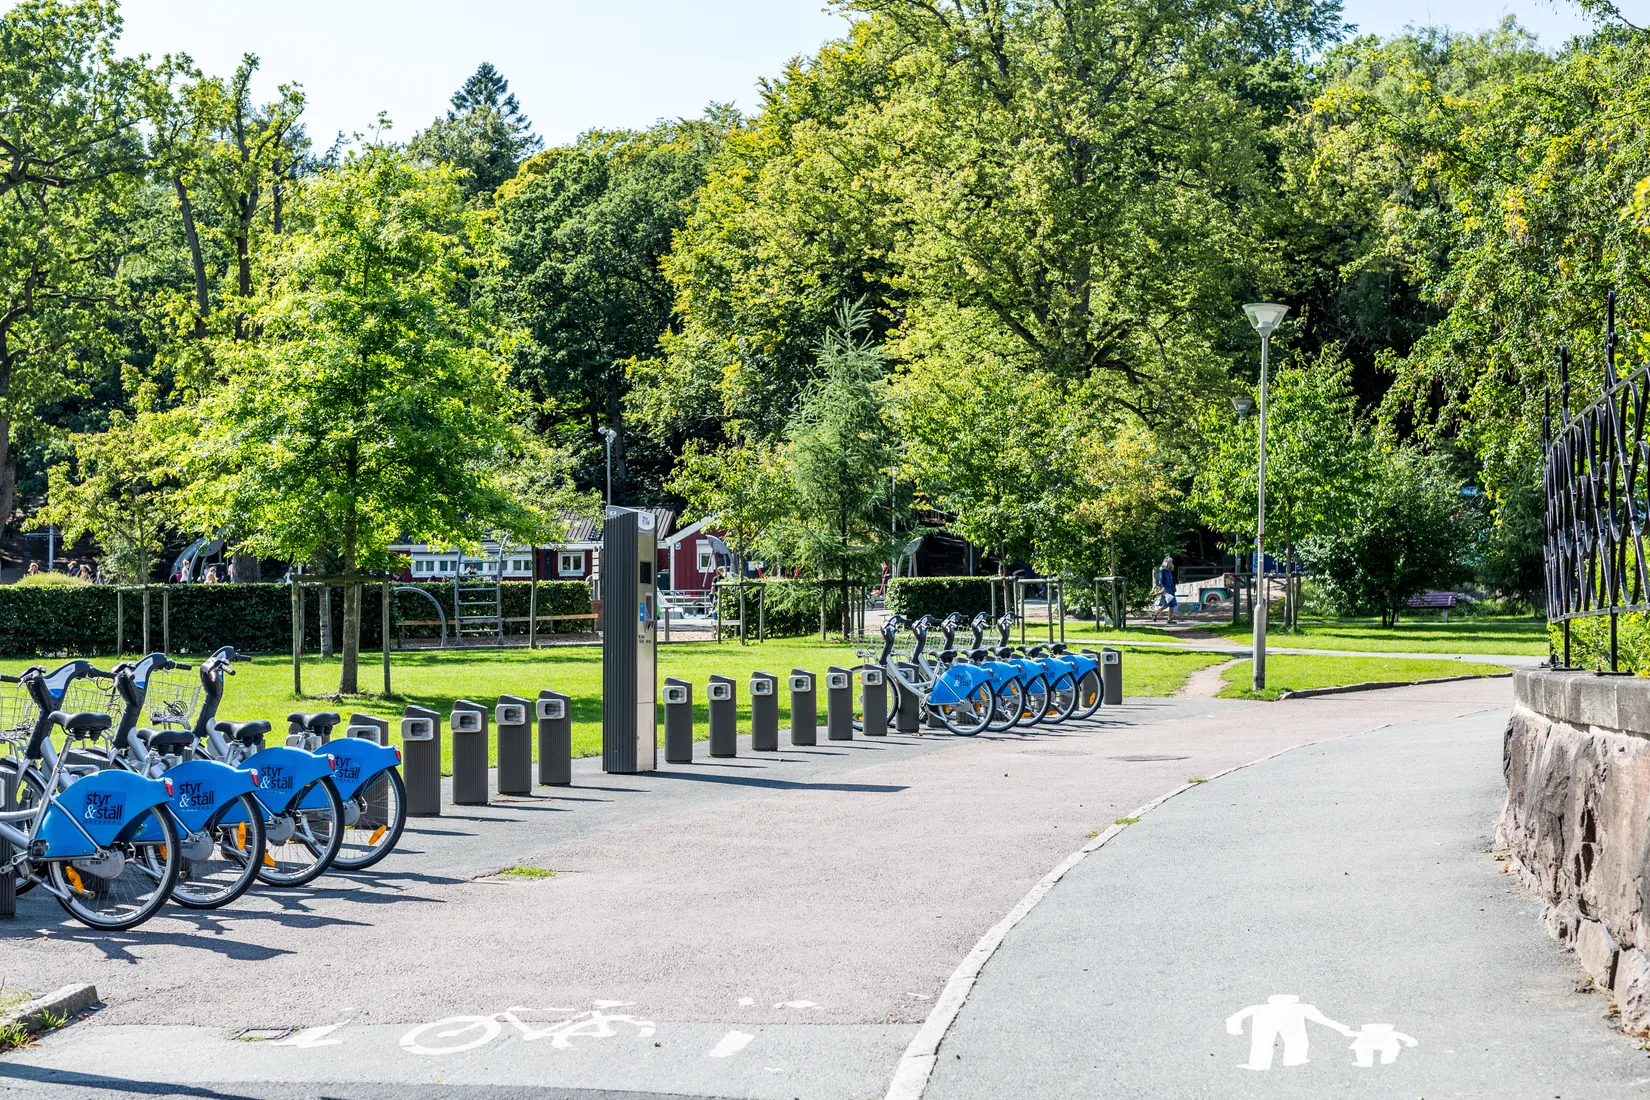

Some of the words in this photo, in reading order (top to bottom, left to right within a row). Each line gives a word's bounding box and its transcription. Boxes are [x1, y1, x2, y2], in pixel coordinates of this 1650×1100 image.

[333, 755, 351, 769] tyr
[261, 764, 283, 779] styr
[179, 781, 202, 796] styr
[86, 791, 111, 807] styr
